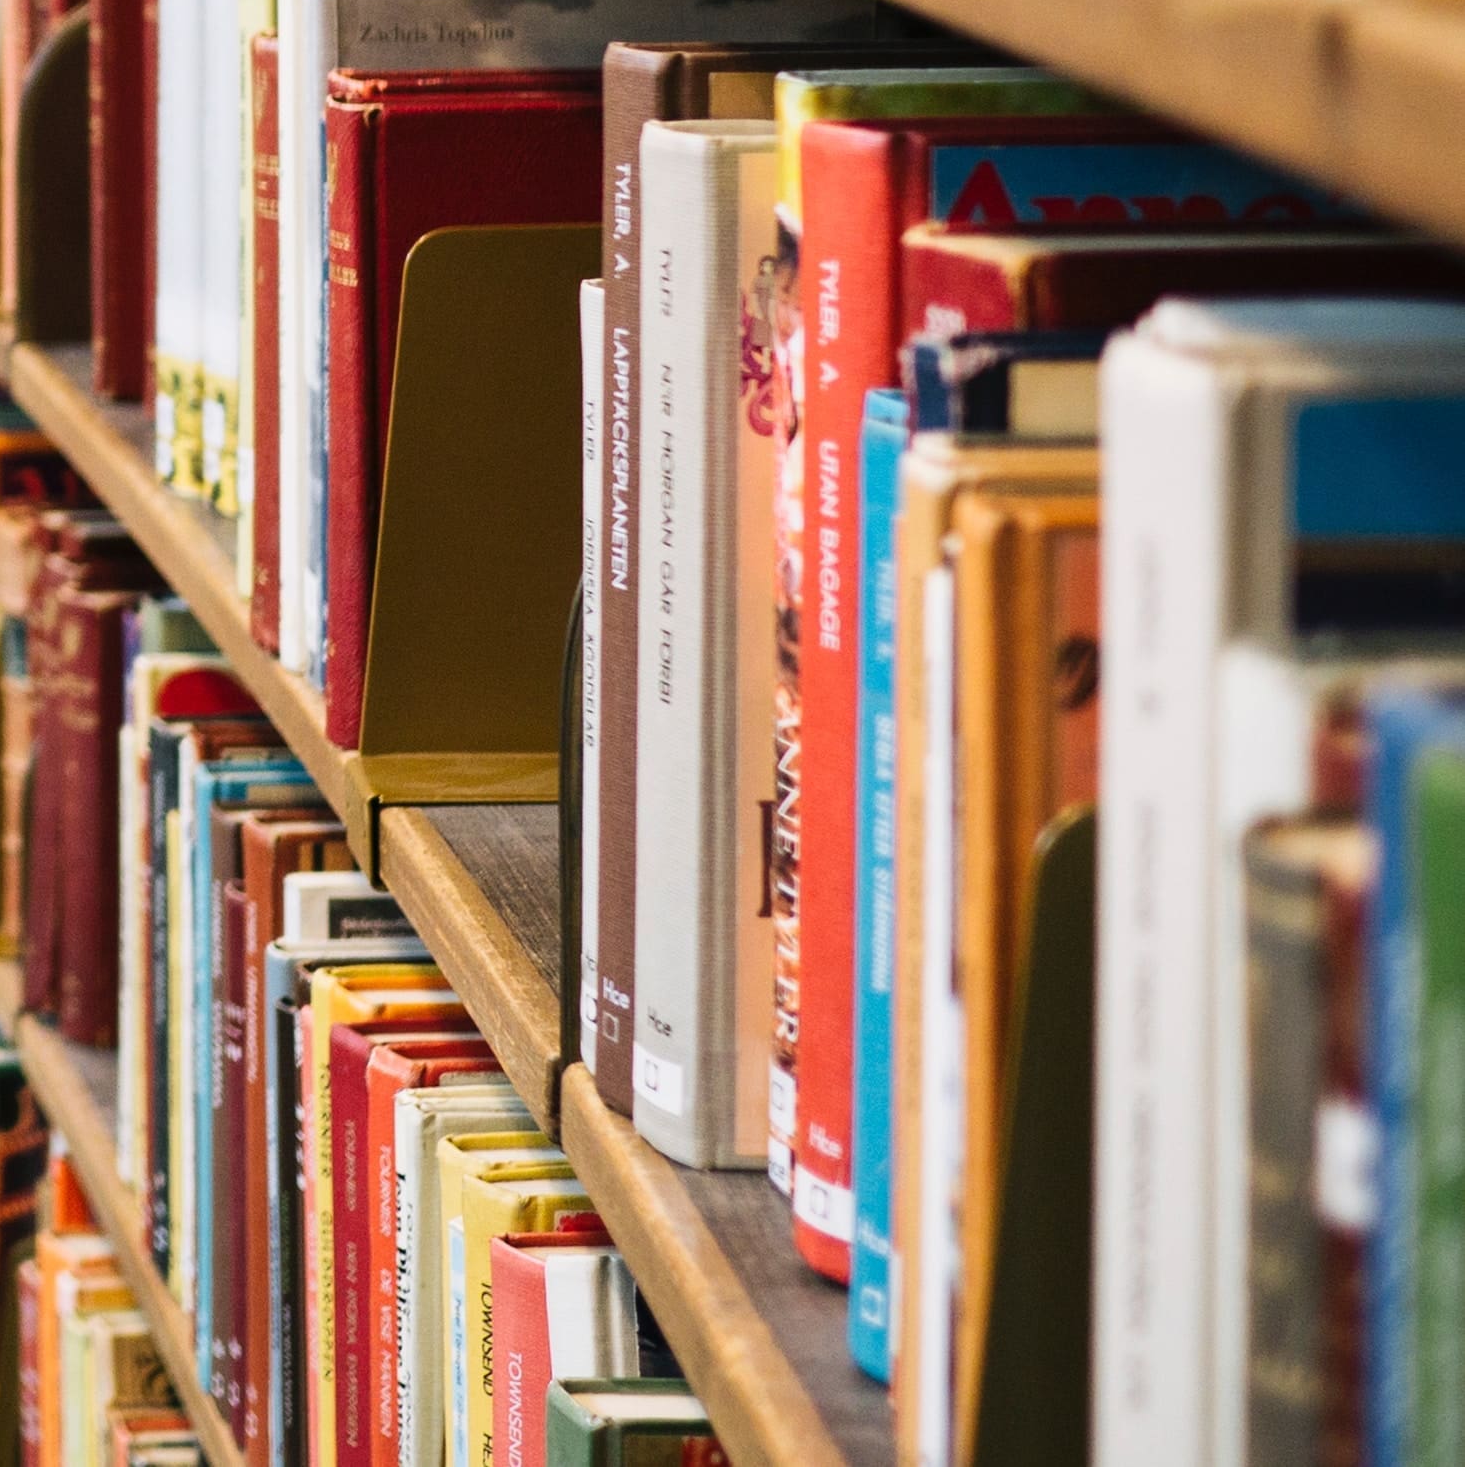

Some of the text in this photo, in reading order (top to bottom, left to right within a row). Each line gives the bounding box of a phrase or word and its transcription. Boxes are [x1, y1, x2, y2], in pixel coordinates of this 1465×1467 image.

[438, 21, 516, 48] Topelius
[613, 163, 632, 240] TYLER,
[659, 246, 674, 319] TYLER
[660, 364, 674, 417] NÄR
[612, 327, 630, 591] LAPPTÄCKSPLANETEN
[660, 429, 674, 547] MORGAN
[819, 438, 841, 519] UTAN
[660, 560, 676, 615] GÅR
[819, 527, 842, 652] BAGAGE
[603, 977, 631, 1010] Hce
[381, 1144, 392, 1237] TOURNIER
[381, 1269, 392, 1295] DE
[382, 1305, 392, 1344] VISE
[481, 1282, 493, 1397] TOWNSEND
[508, 1350, 523, 1467] TOWNSEND
